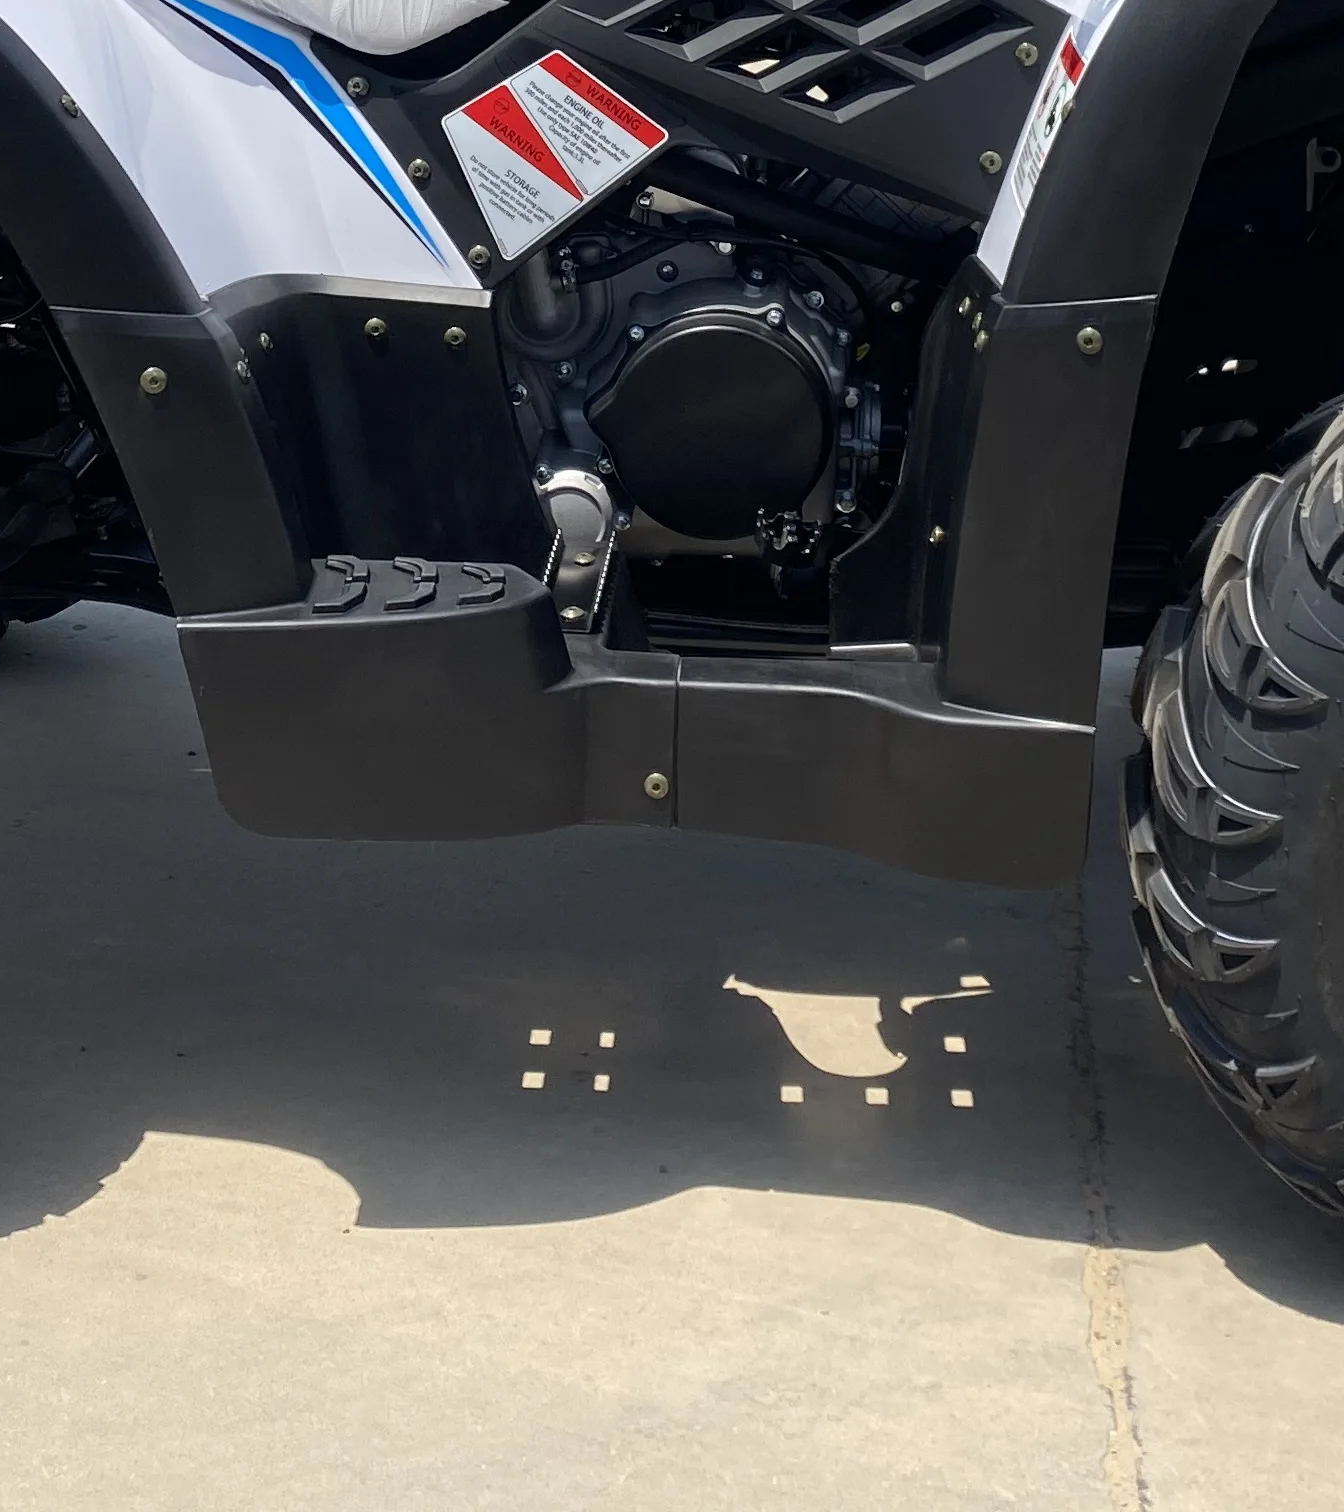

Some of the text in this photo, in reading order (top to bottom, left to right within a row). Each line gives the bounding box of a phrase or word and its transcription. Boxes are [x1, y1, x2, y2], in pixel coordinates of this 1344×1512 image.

[528, 80, 546, 96] Please
[543, 92, 564, 110] change
[561, 107, 575, 120] your
[573, 115, 592, 132] engine
[591, 127, 600, 136] oil
[598, 133, 612, 145] after
[610, 142, 620, 152] the
[536, 106, 547, 116] Use
[545, 113, 559, 126] only
[569, 130, 580, 141] SAE
[563, 94, 606, 129] ENGINE OIL
[584, 84, 642, 131] WARNING
[487, 115, 545, 163] WARNING
[546, 124, 570, 144] Capacity
[573, 145, 593, 162] engine
[557, 111, 571, 124] each
[583, 131, 598, 144] miles
[469, 154, 479, 164] Do
[477, 160, 488, 171] not
[486, 167, 501, 180] store
[498, 177, 518, 193] vehicle
[516, 190, 526, 199] for
[523, 196, 537, 209] long
[477, 170, 490, 182] time
[488, 179, 502, 190] with
[499, 188, 510, 199] gas
[532, 211, 545, 223] with
[503, 168, 540, 199] STORAGE
[497, 195, 518, 213] battery
